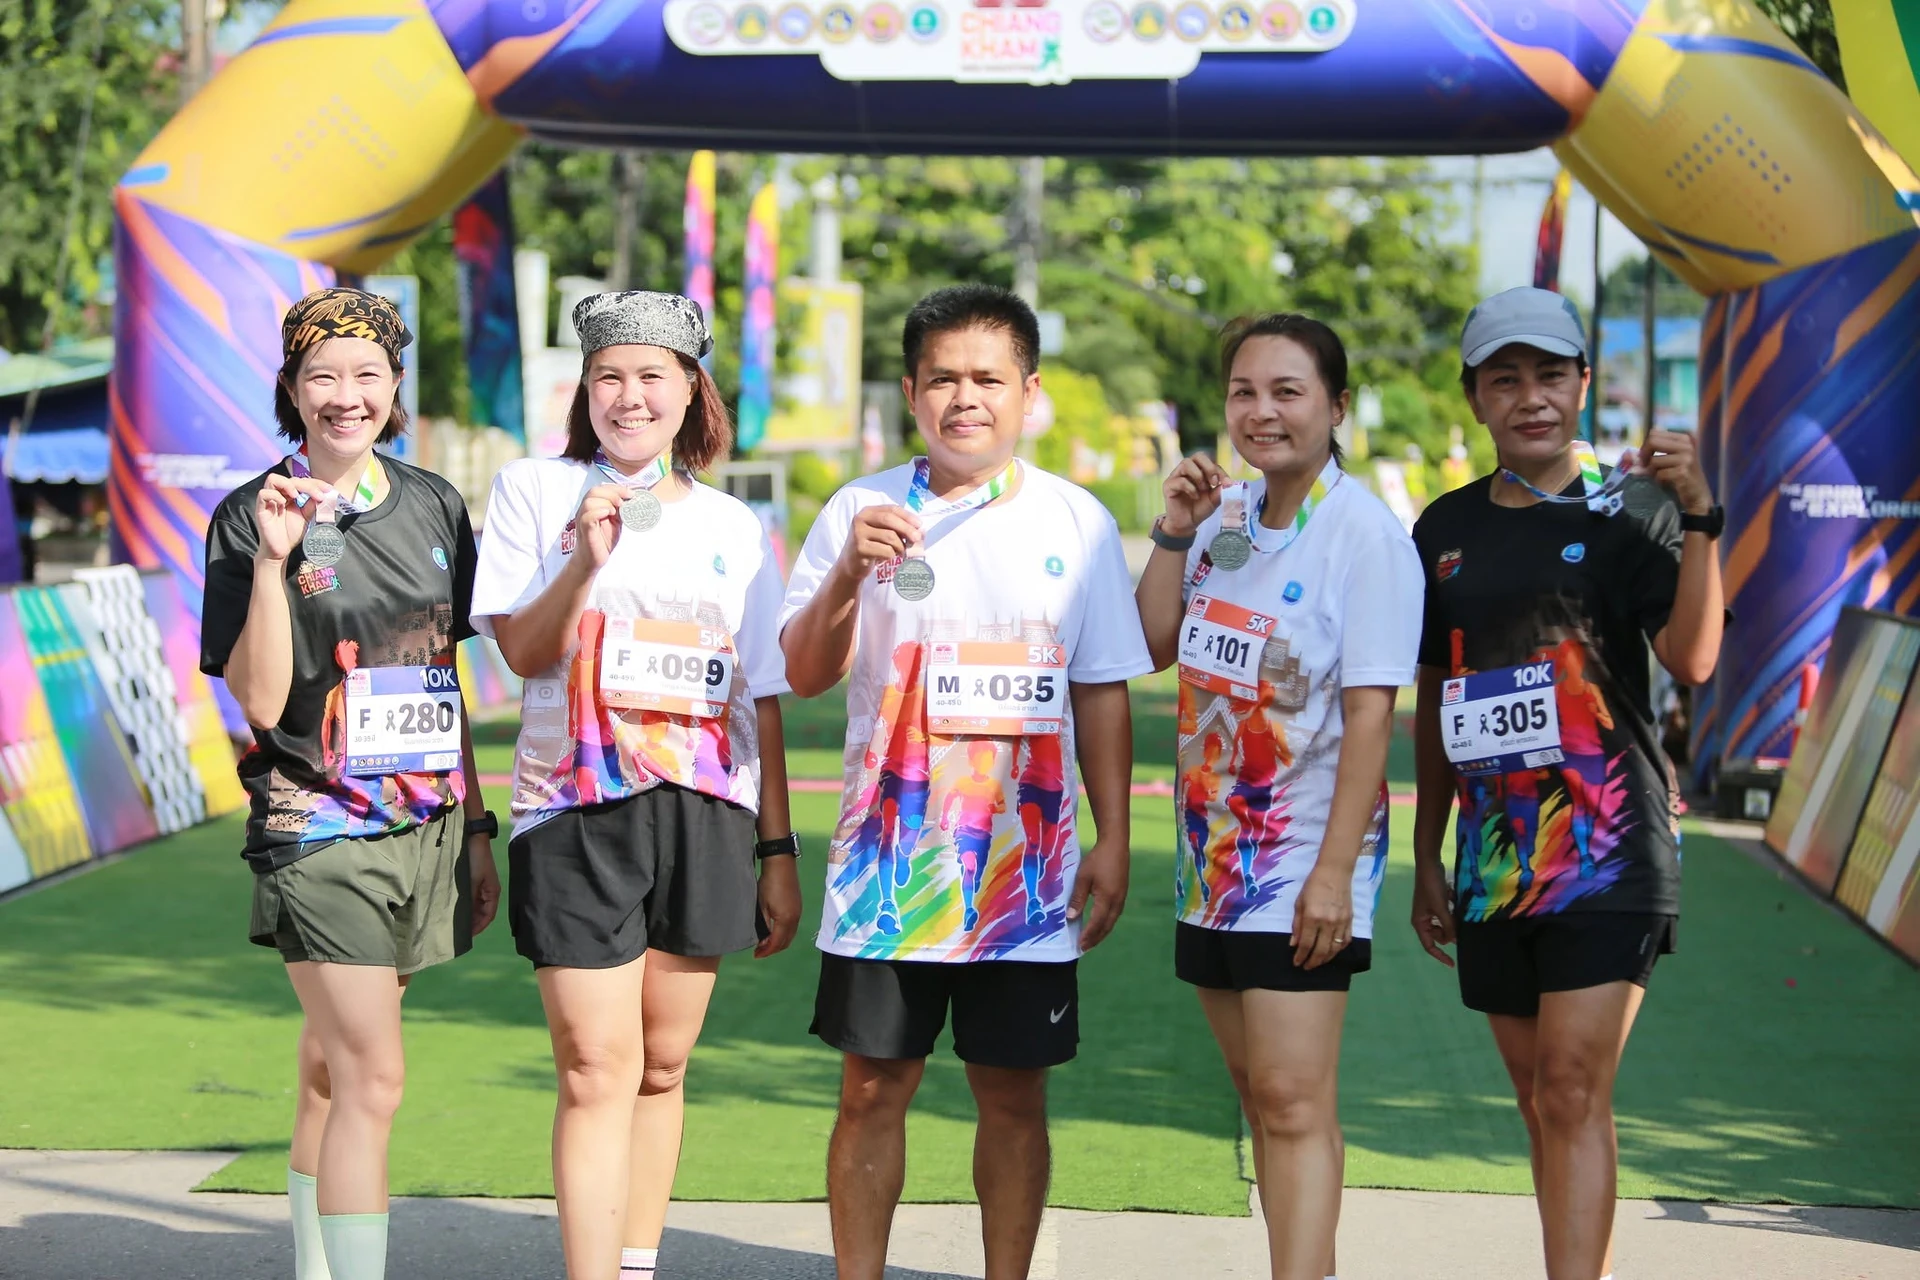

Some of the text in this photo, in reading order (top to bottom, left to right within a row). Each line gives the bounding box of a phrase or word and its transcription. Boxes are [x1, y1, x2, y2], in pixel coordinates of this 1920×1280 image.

[961, 11, 1061, 33] CHIANG
[961, 40, 1037, 58] KHAM
[298, 567, 336, 585] CHIANG
[301, 577, 332, 595] KHAM
[1245, 613, 1275, 634] 5K
[700, 630, 726, 649] 5K
[1188, 626, 1250, 668] F 101
[1028, 646, 1061, 664] 5K
[420, 668, 457, 688] 10K
[617, 649, 725, 686] F 099
[1513, 663, 1552, 687] 10K
[938, 674, 1054, 702] M 035
[360, 701, 454, 735] F 280
[1454, 698, 1547, 737] F 305
